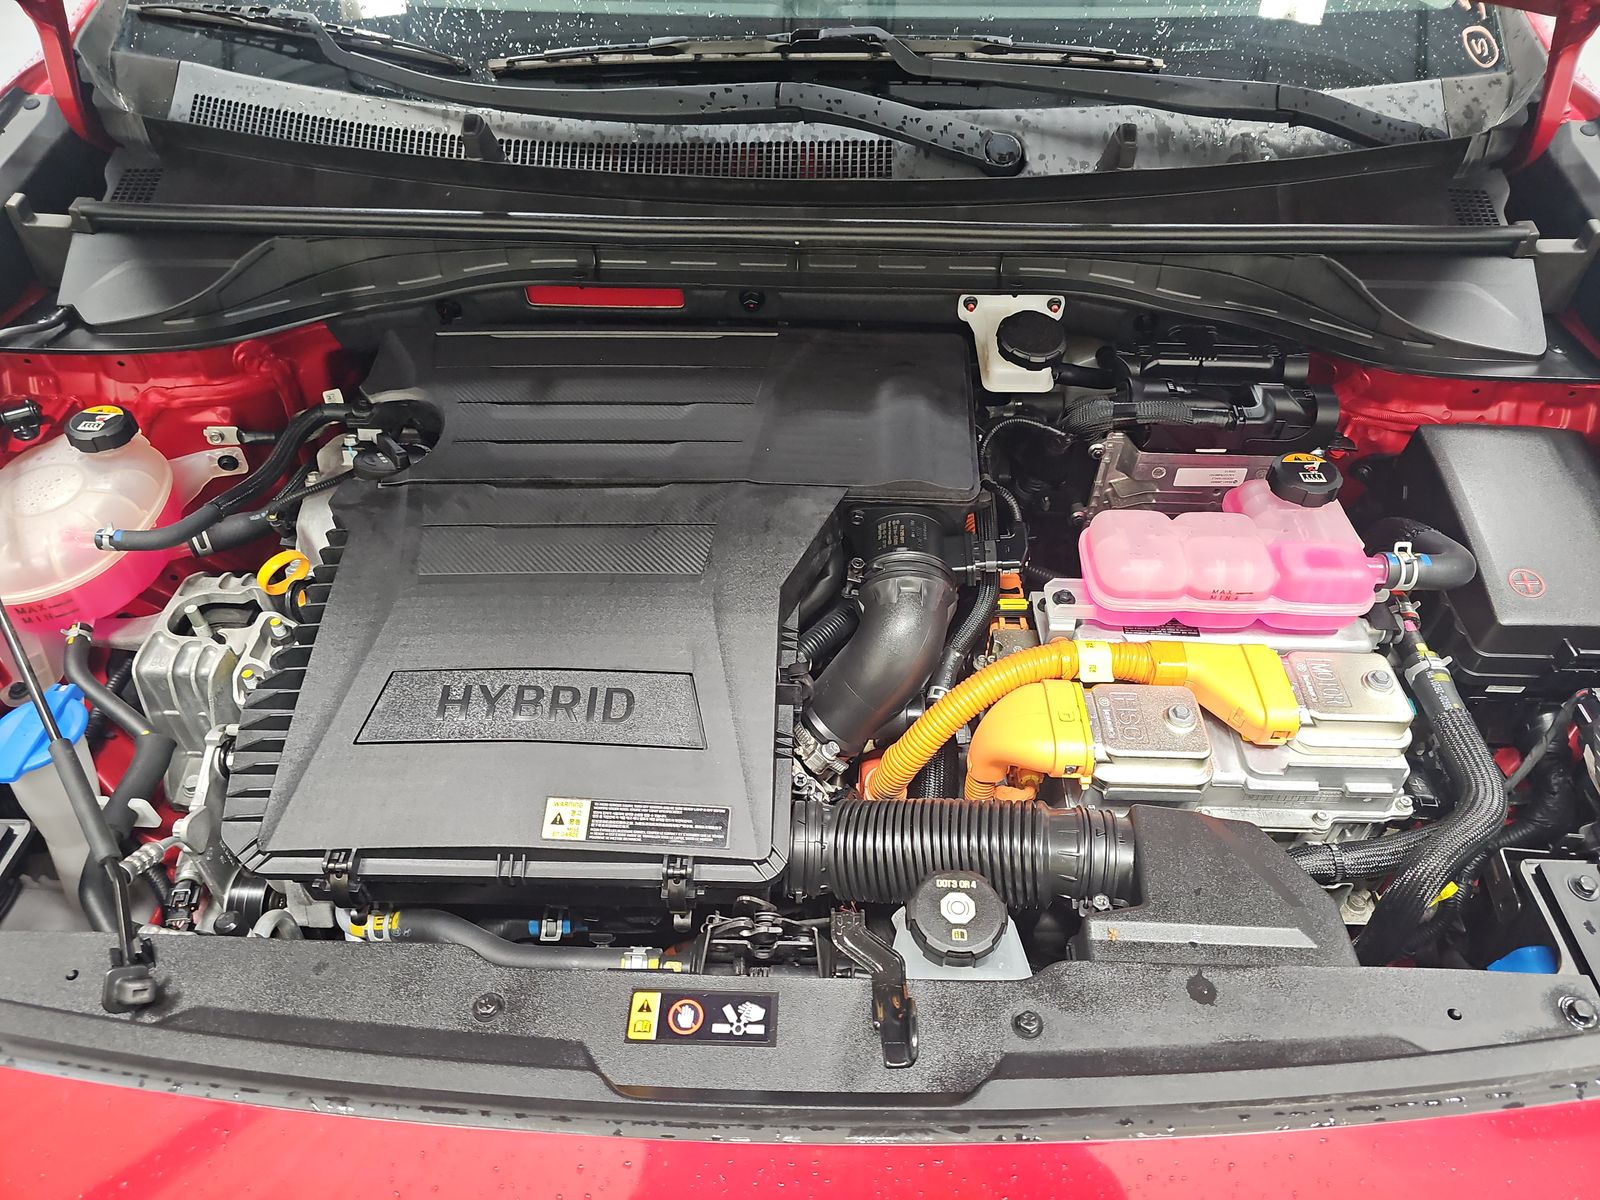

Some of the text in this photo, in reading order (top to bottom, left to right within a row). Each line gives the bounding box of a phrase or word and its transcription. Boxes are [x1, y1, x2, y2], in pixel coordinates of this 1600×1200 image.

[14, 603, 46, 614] MAX
[22, 613, 54, 624] MIN
[435, 684, 635, 723] HYBRID
[971, 880, 977, 889] 4
